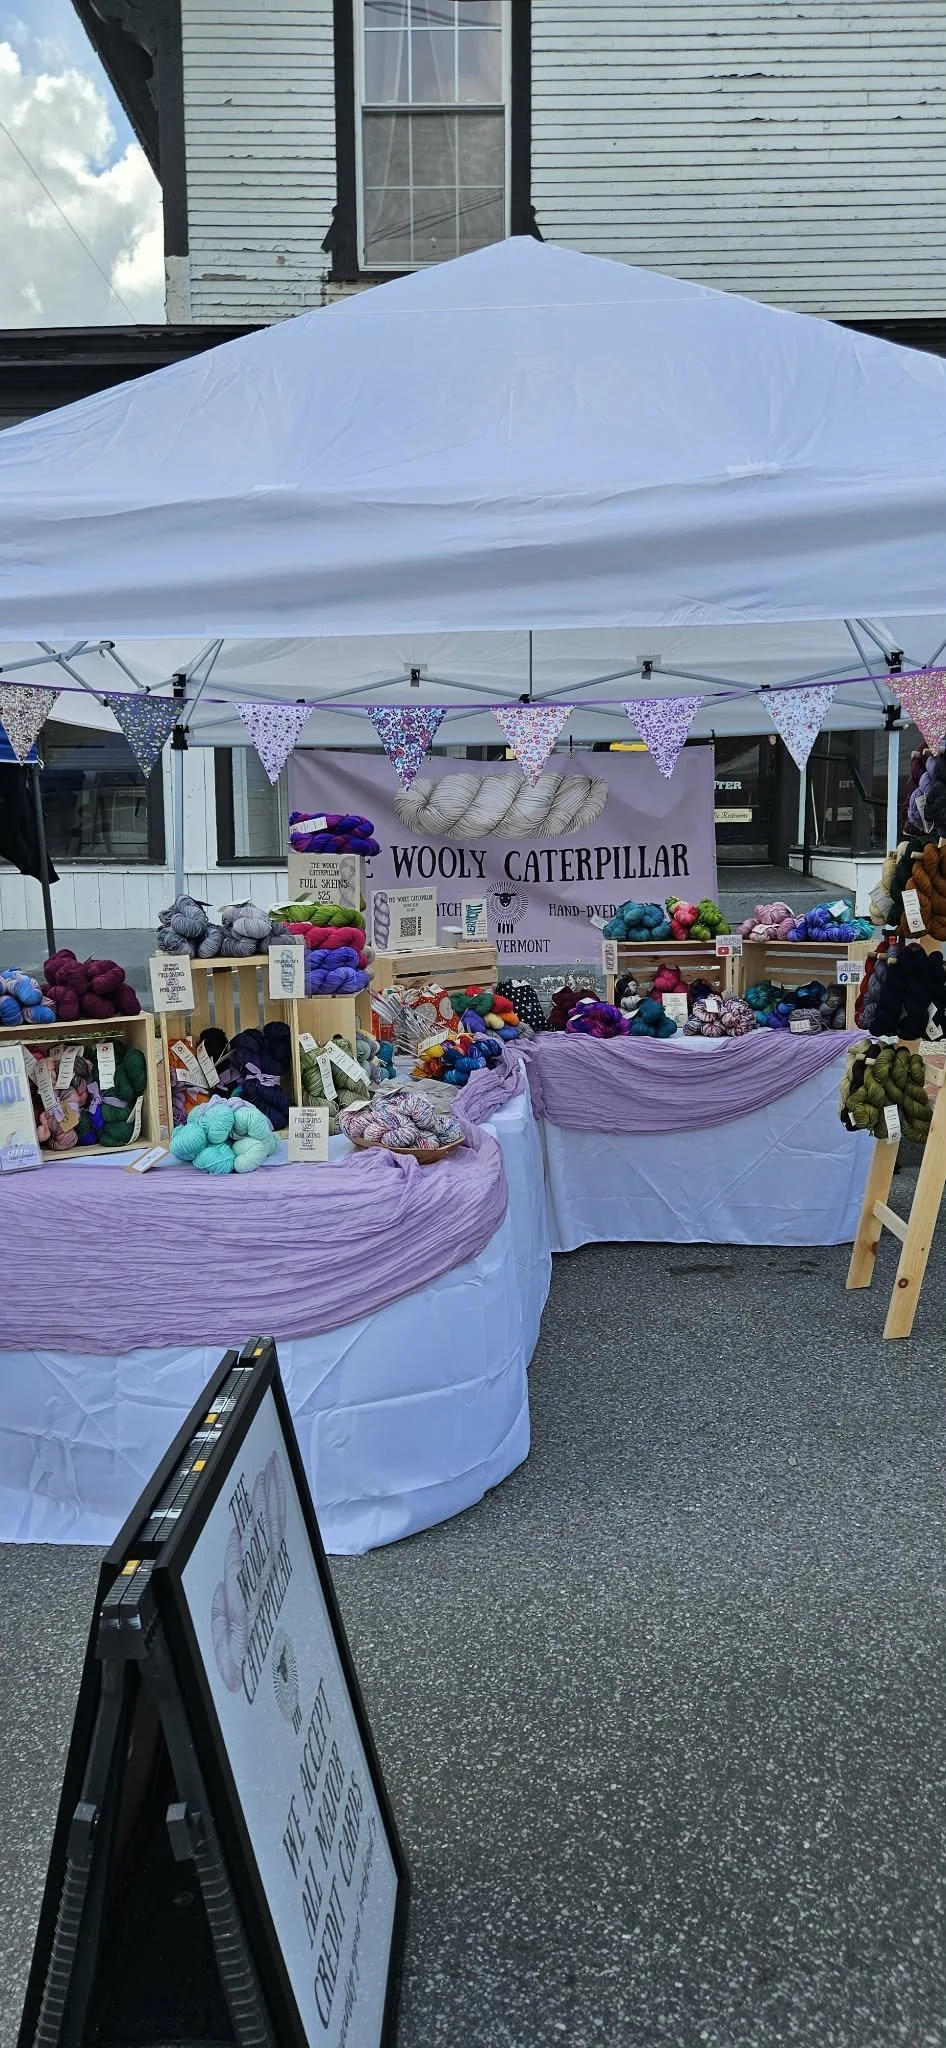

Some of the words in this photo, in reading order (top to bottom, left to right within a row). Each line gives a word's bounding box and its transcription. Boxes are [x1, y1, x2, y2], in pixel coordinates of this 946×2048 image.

[300, 879, 317, 889] FULL
[321, 879, 349, 889] SKEINS
[317, 891, 331, 900] $25
[390, 846, 486, 880] WOOLY
[504, 843, 690, 883] CATERPILLAR
[548, 903, 617, 918] HAND-DYED
[496, 939, 550, 953] VERMONT
[229, 1472, 253, 1539] THE
[237, 1511, 270, 1611] WOOLY
[242, 1538, 293, 1706] CATERPILLAR
[282, 1795, 306, 1880] WE
[299, 1676, 332, 1816] ACCEPT
[301, 1855, 323, 1949] ALL
[314, 1740, 345, 1871] MAJOR
[314, 1874, 346, 2030] CREDIT
[338, 1770, 364, 1888] CARDS
